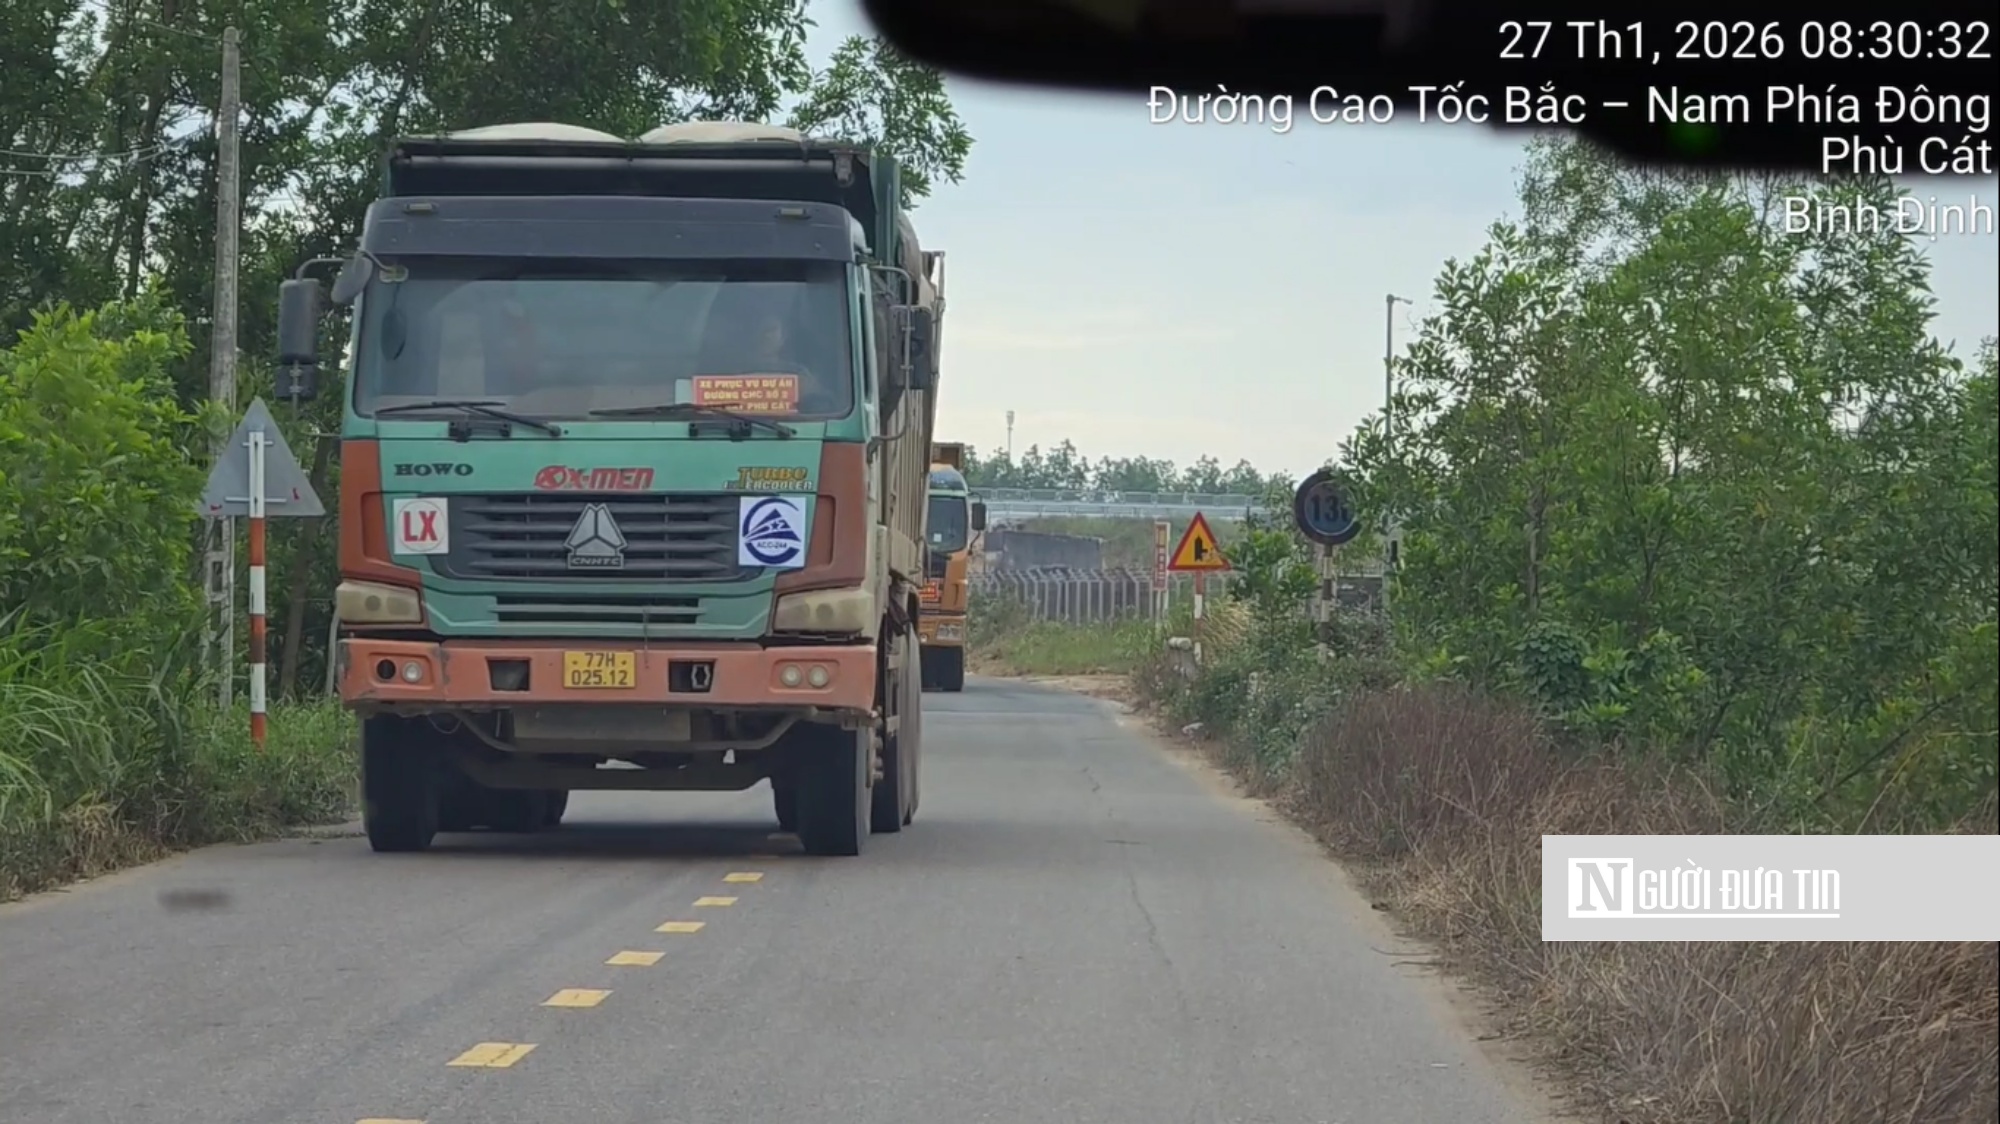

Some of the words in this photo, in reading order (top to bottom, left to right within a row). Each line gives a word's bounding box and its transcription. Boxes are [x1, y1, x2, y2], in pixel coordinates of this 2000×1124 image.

[394, 463, 474, 477] HOWO
[738, 467, 808, 487] TURBO
[403, 511, 438, 542] LX
[571, 556, 619, 566] CNHTC
[584, 652, 616, 668] 77H
[571, 669, 629, 686] 025.12
